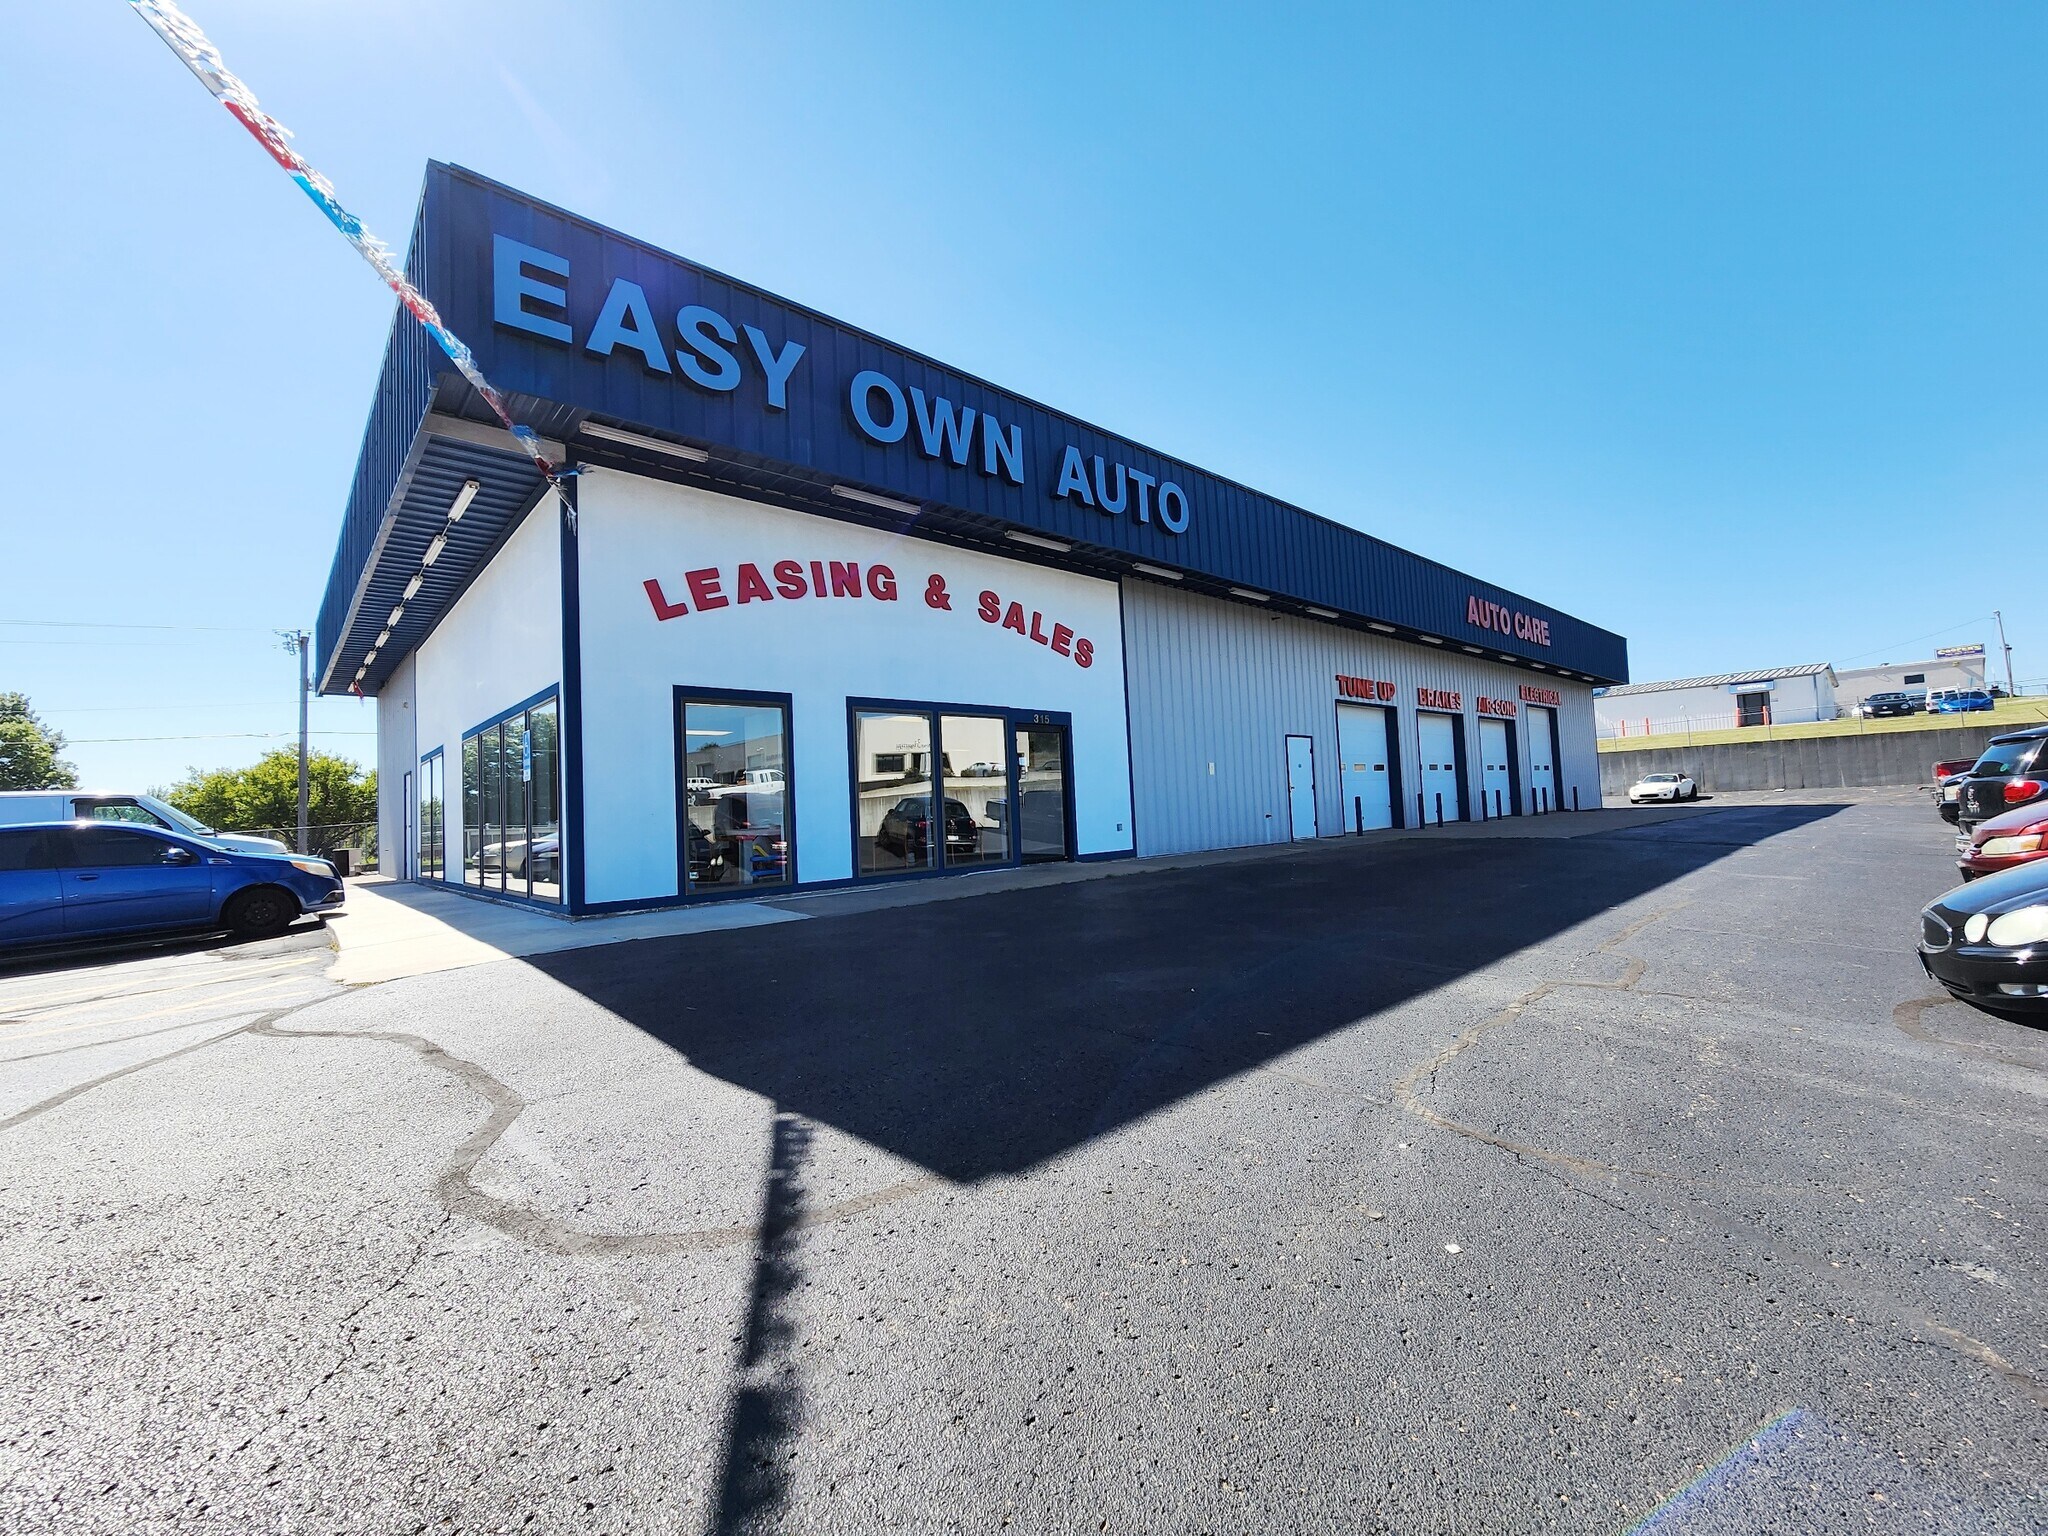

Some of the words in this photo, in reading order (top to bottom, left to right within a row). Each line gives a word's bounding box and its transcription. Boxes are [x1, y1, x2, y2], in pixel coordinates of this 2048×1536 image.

[494, 233, 807, 410] EASY
[849, 370, 1026, 485] OWN
[1056, 445, 1191, 535] AUTO
[643, 560, 898, 621] LEASING
[924, 574, 952, 611] &
[977, 590, 1094, 668] SALES
[1467, 595, 1511, 635] AUTO
[1514, 611, 1551, 646] CARE
[1336, 674, 1375, 700] TUNE
[1377, 681, 1396, 701] UP
[1417, 687, 1462, 710] BRAKES
[1519, 684, 1561, 706] ELECTRICAL
[1033, 713, 1050, 724] 315
